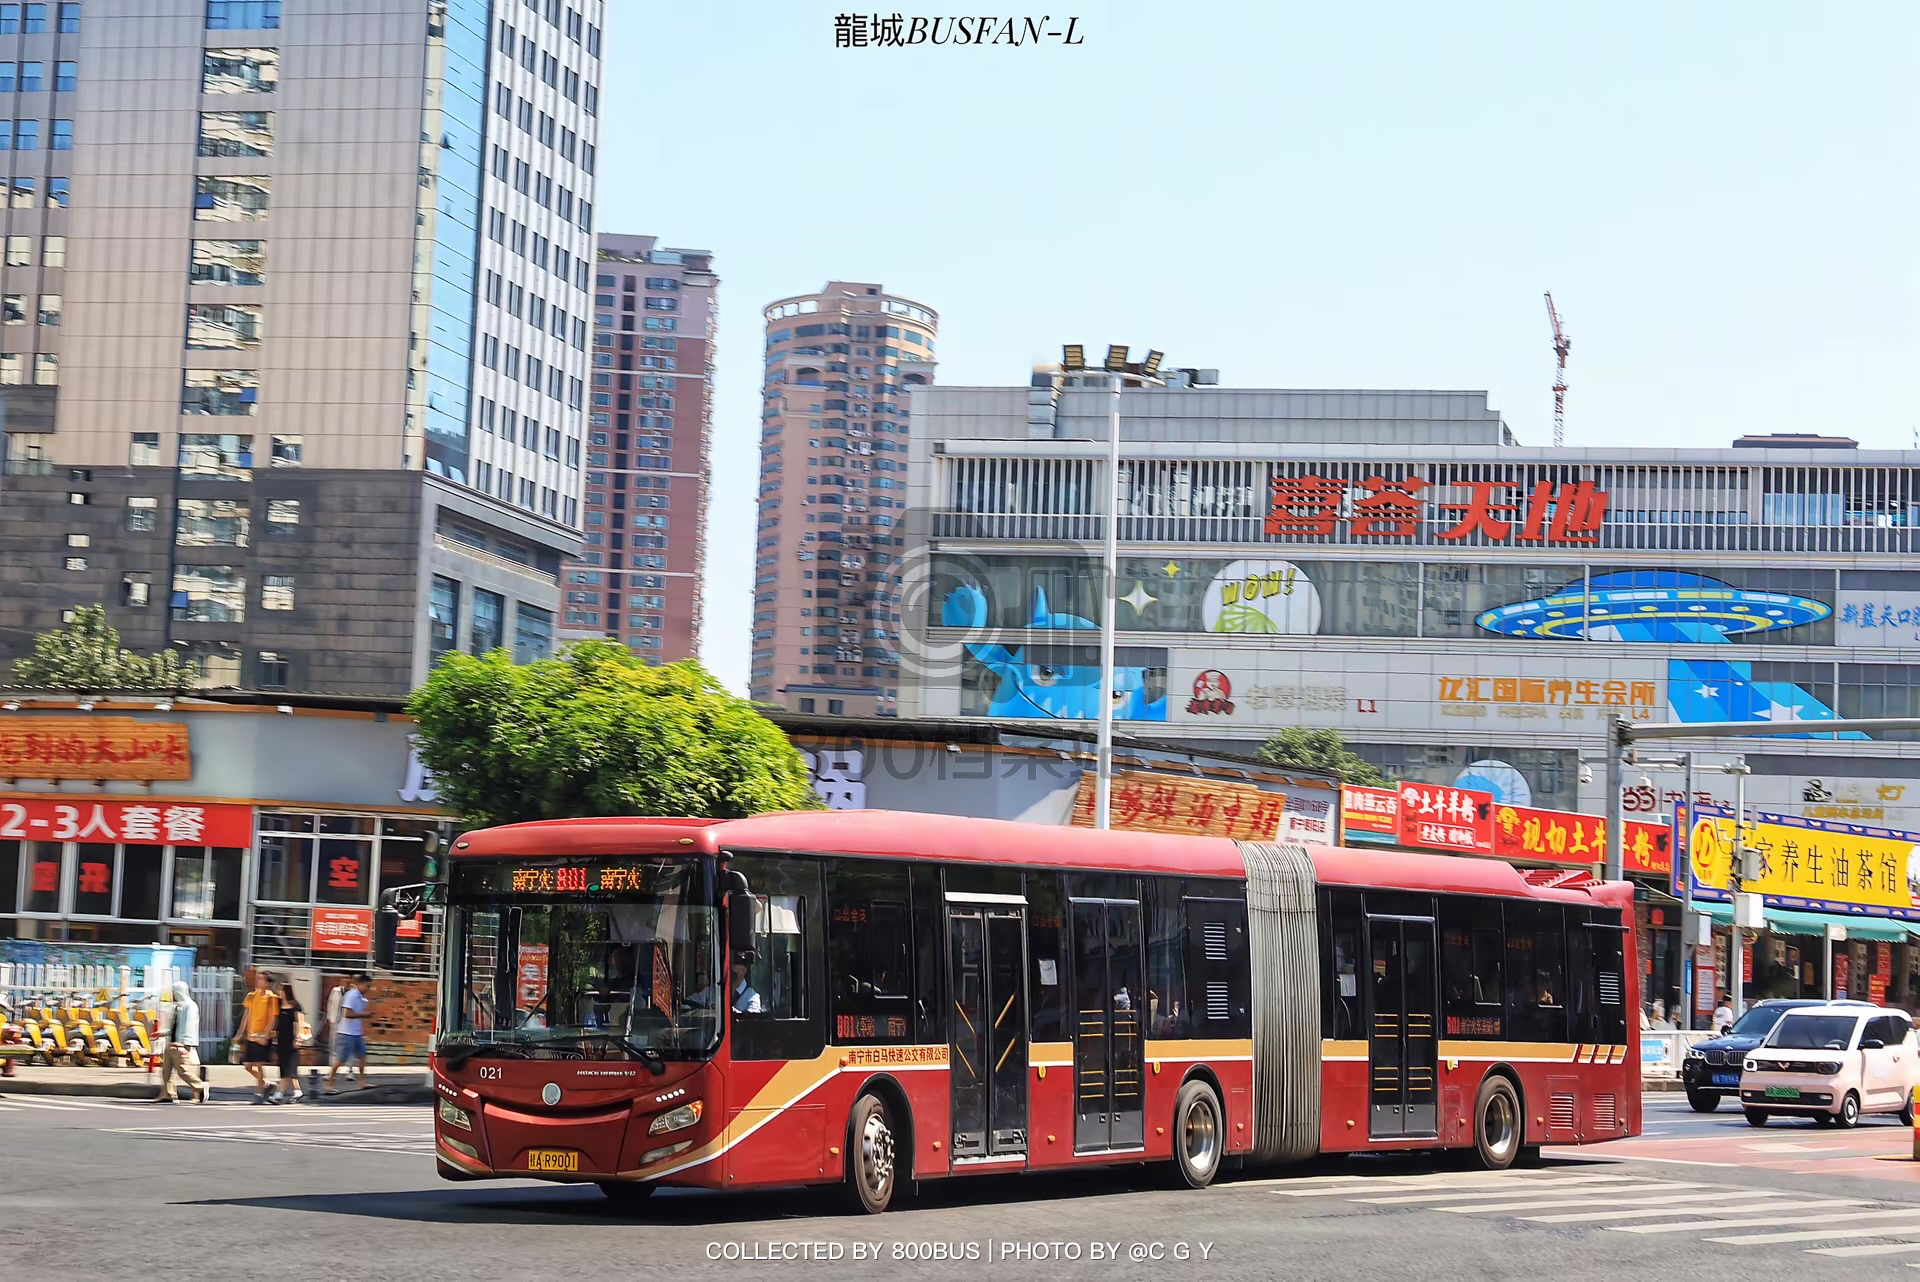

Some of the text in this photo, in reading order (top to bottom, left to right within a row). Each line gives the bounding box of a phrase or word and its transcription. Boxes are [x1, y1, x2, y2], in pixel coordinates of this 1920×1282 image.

[1222, 568, 1297, 606] WOW!
[0, 803, 205, 842] 2-3人套餐
[480, 1066, 502, 1080] 021
